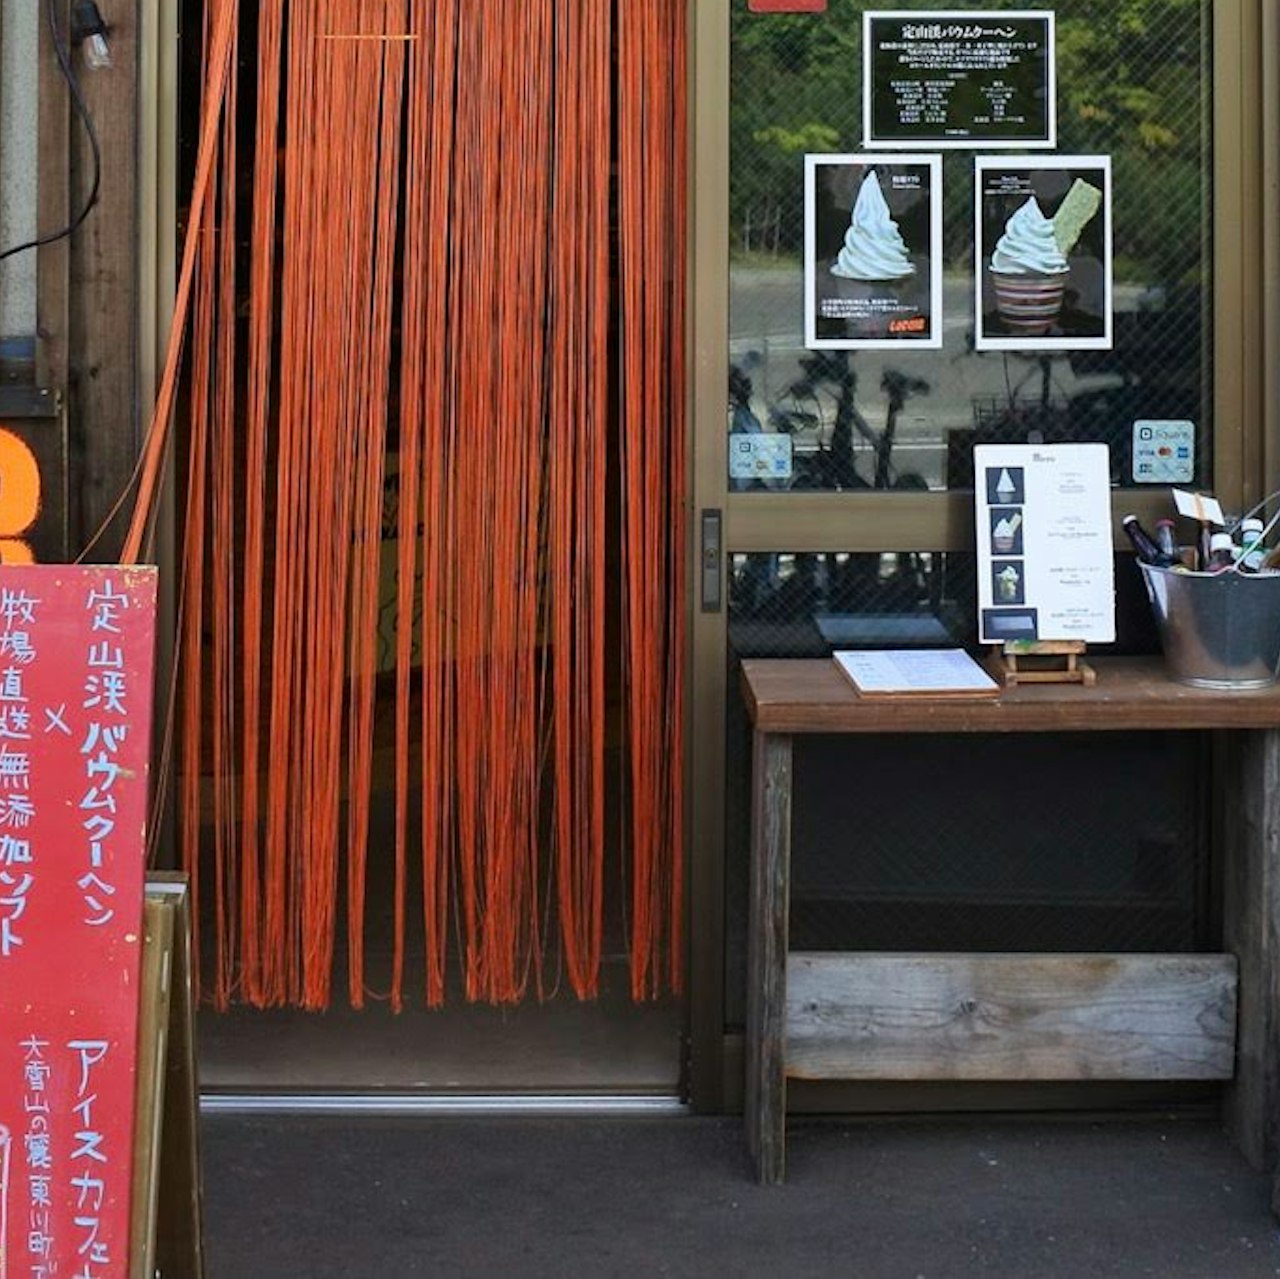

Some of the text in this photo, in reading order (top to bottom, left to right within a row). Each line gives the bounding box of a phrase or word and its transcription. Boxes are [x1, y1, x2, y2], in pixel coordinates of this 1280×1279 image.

[76, 578, 130, 927] 定山渓バウムクーヘン
[66, 1039, 110, 1279] アイスカフェ
